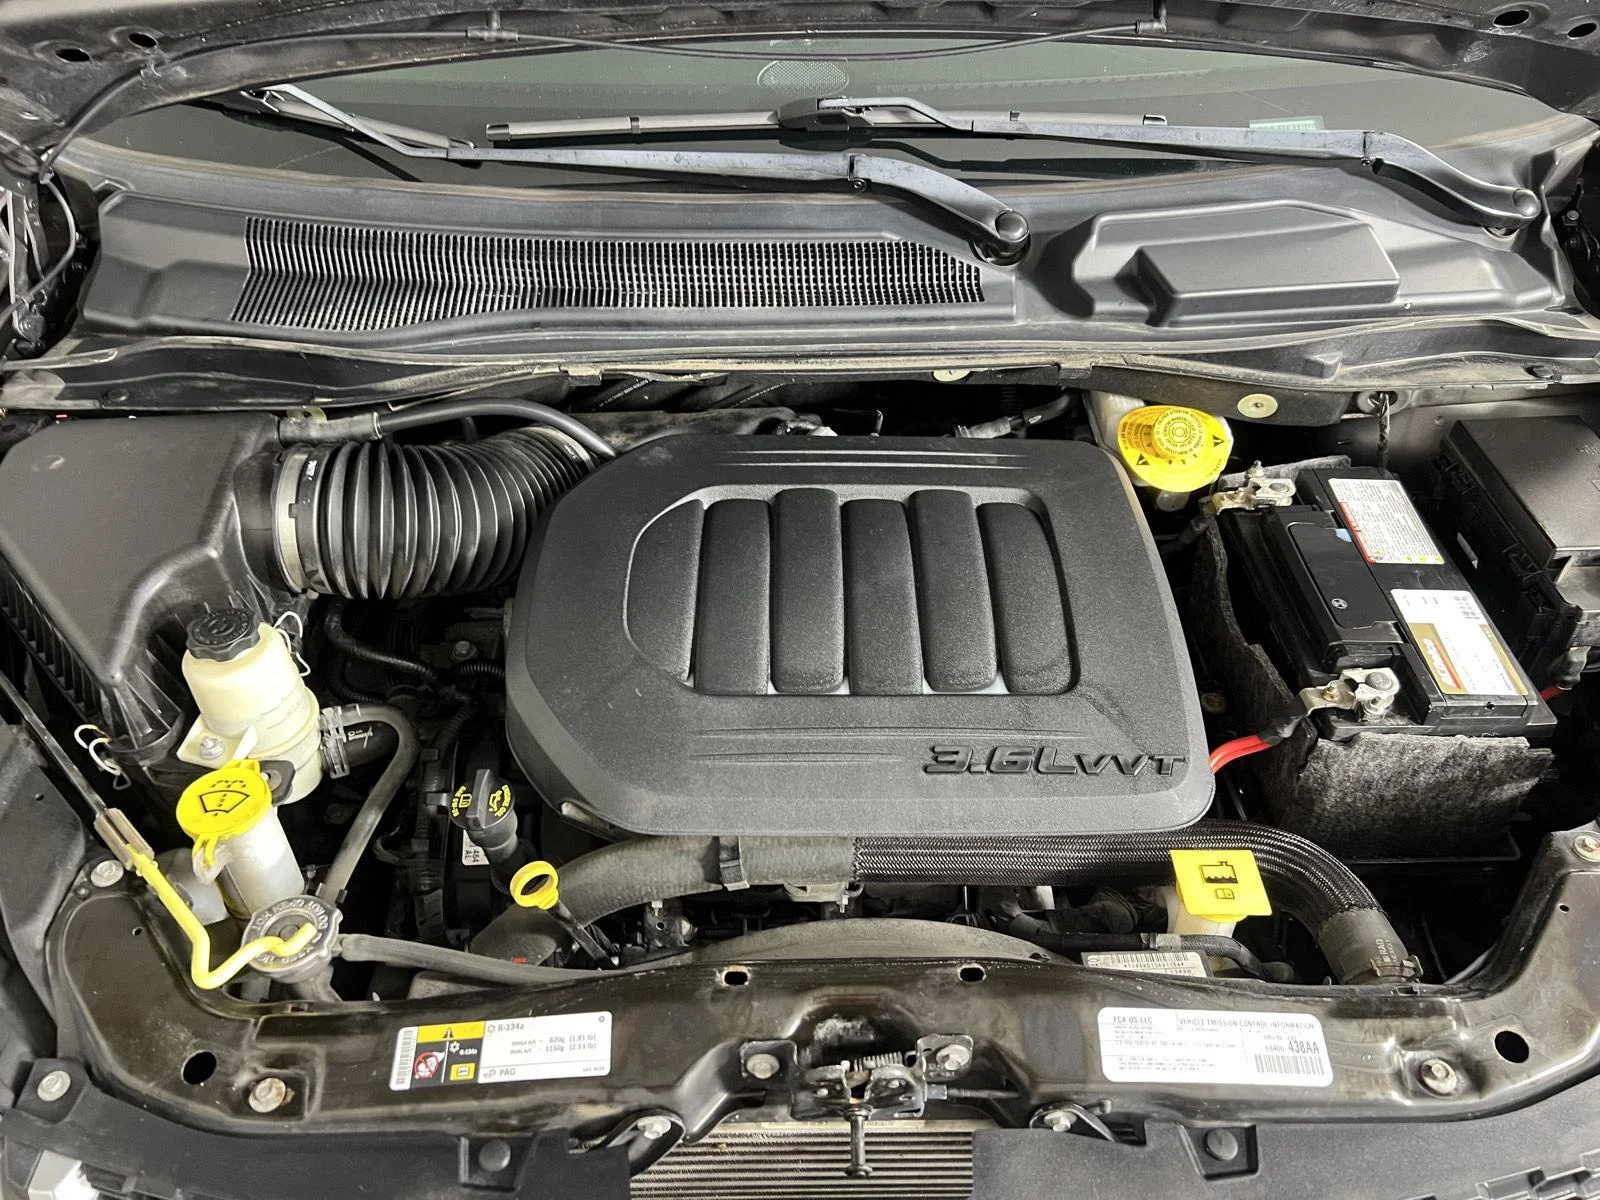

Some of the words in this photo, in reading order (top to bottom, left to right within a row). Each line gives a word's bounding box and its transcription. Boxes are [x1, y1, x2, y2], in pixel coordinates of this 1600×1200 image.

[498, 1023, 525, 1032] R-134a
[1180, 1018, 1205, 1026] VEHICLE
[1207, 1019, 1237, 1027] EMISSION
[1240, 1020, 1268, 1028] CONTROL
[1271, 1020, 1314, 1029] INFORMATION
[1288, 1039, 1320, 1054] 438AA
[499, 1068, 516, 1077] PAG
